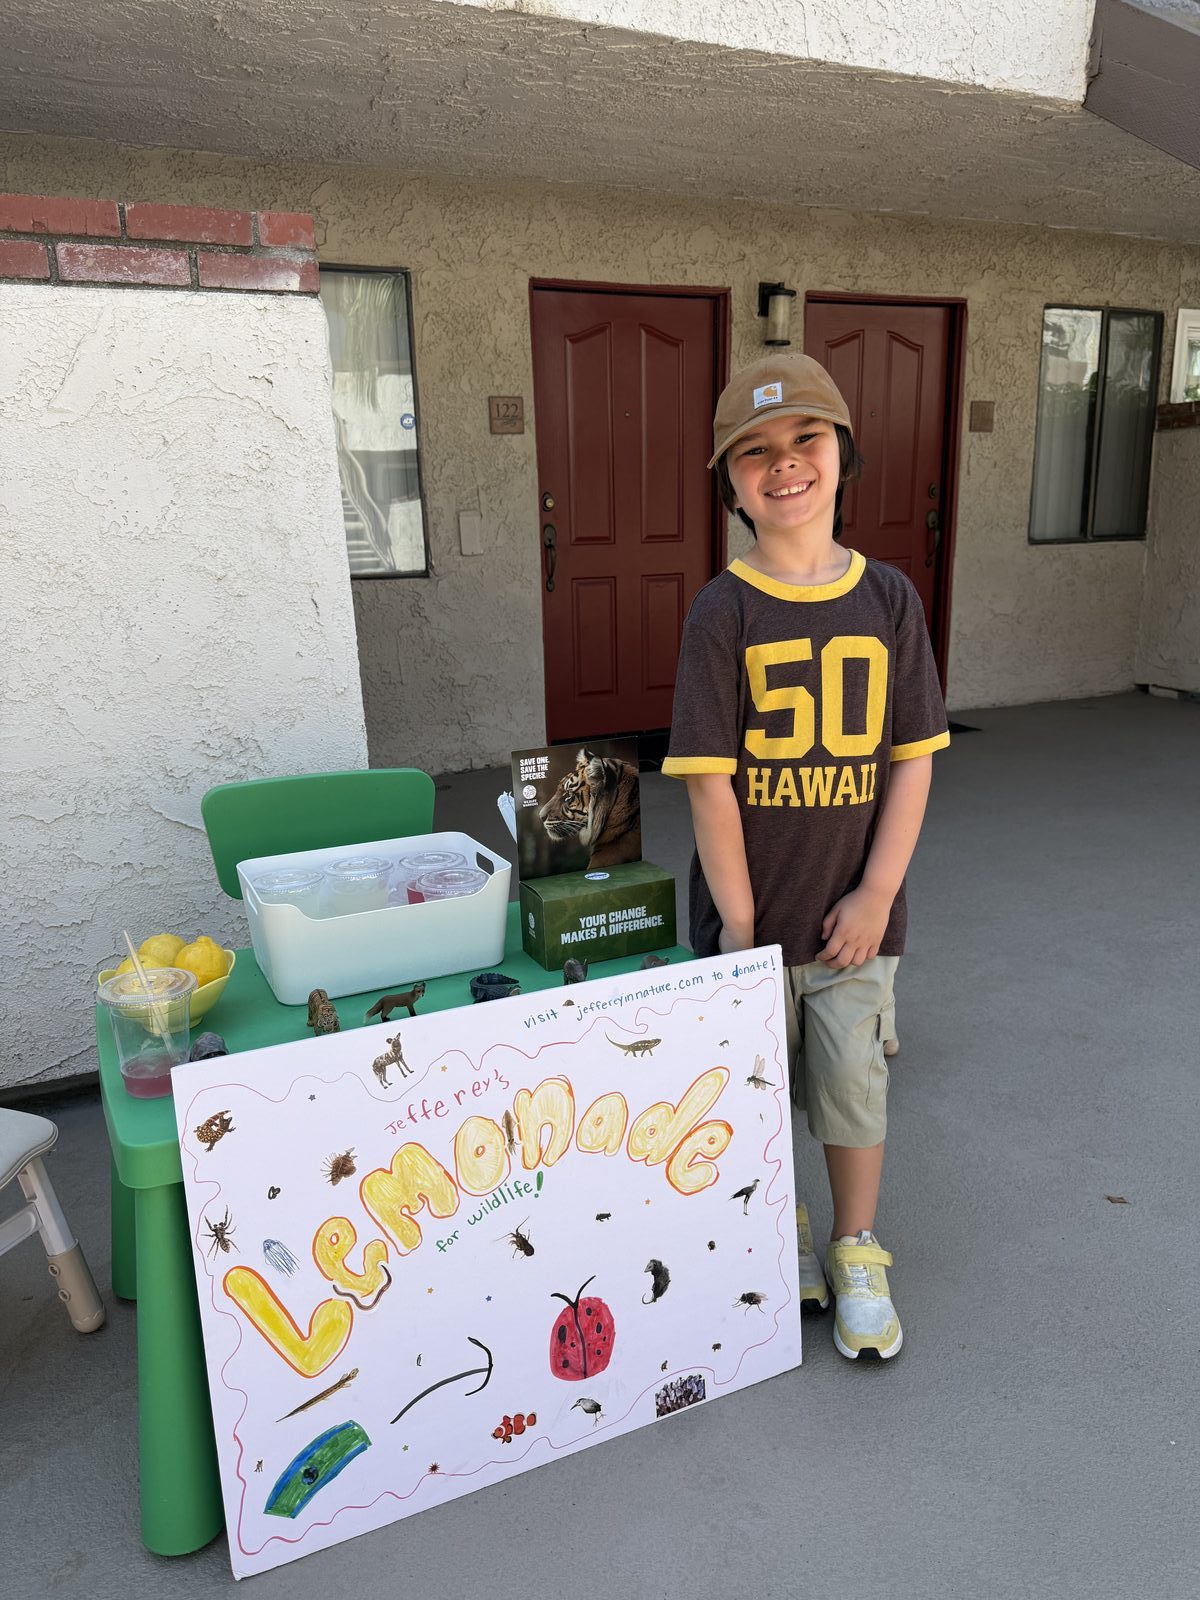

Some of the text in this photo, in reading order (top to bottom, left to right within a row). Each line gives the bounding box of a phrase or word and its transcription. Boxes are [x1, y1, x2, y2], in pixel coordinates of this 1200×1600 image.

[496, 403, 519, 418] 122
[745, 636, 889, 760] 50
[520, 758, 536, 767] SAVE
[521, 765, 537, 774] SAVE
[747, 762, 877, 807] HAWAII
[561, 915, 665, 945] MAKES A DIFFERENCE.
[579, 905, 647, 929] YOUR CHANGE
[524, 1008, 558, 1029] visit
[711, 971, 724, 981] to
[732, 955, 776, 978] donate!
[435, 1170, 544, 1253] for wildlife!
